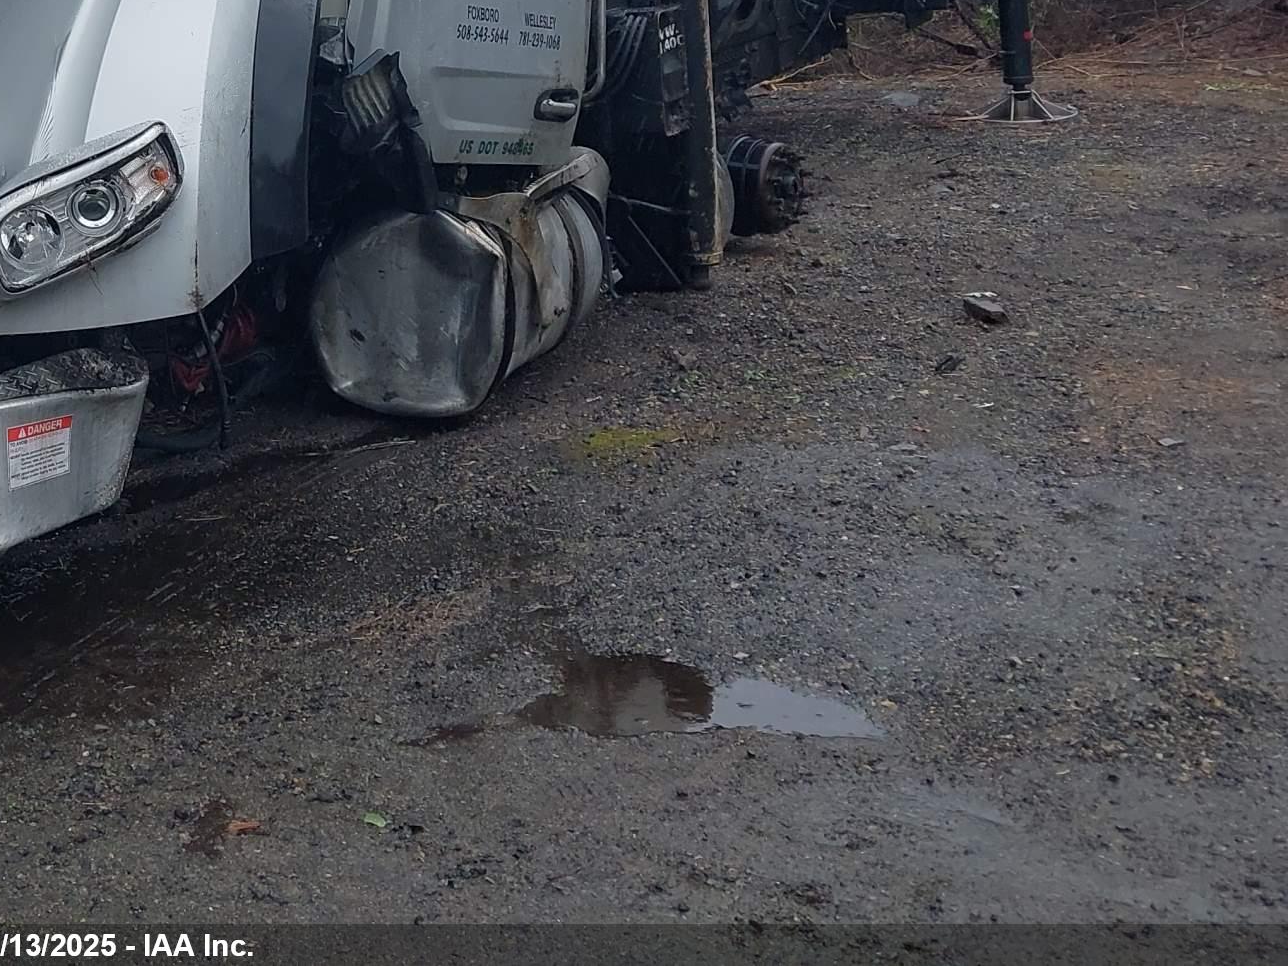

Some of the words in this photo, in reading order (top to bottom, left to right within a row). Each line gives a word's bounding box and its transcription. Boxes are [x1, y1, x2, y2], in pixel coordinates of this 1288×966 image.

[467, 5, 500, 23] FOXBORO
[525, 13, 557, 30] WELLESLEY
[456, 24, 509, 46] 508-543-5644
[518, 31, 561, 50] 781-239-1068
[459, 139, 473, 154] US
[477, 140, 499, 155] DOT
[27, 419, 63, 436] DANGER
